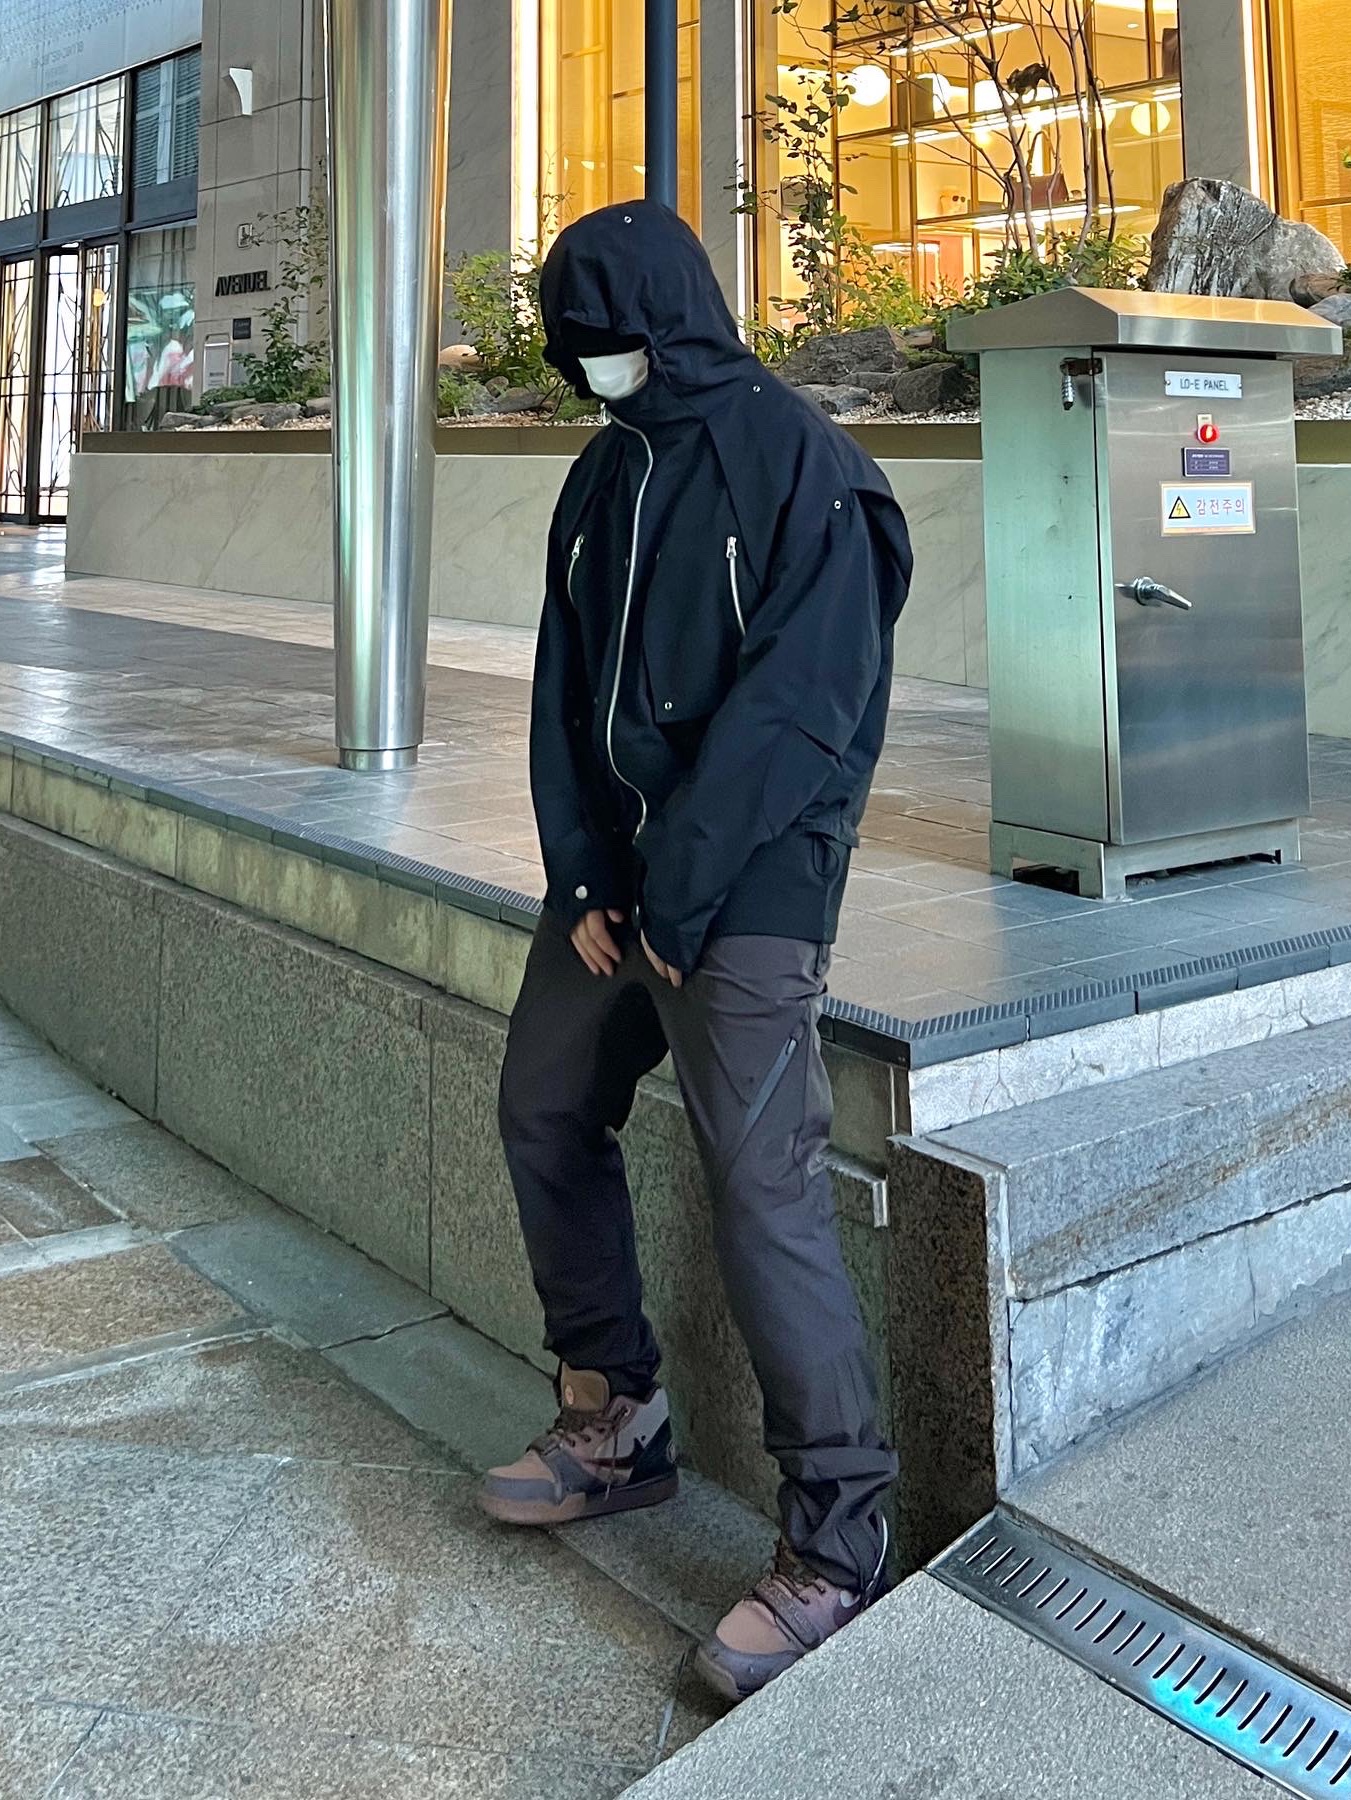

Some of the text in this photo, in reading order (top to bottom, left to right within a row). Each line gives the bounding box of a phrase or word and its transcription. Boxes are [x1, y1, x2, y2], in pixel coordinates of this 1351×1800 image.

[215, 270, 271, 297] AVENUEL
[1204, 379, 1228, 391] PANEL
[1196, 498, 1244, 515] 감전주의
